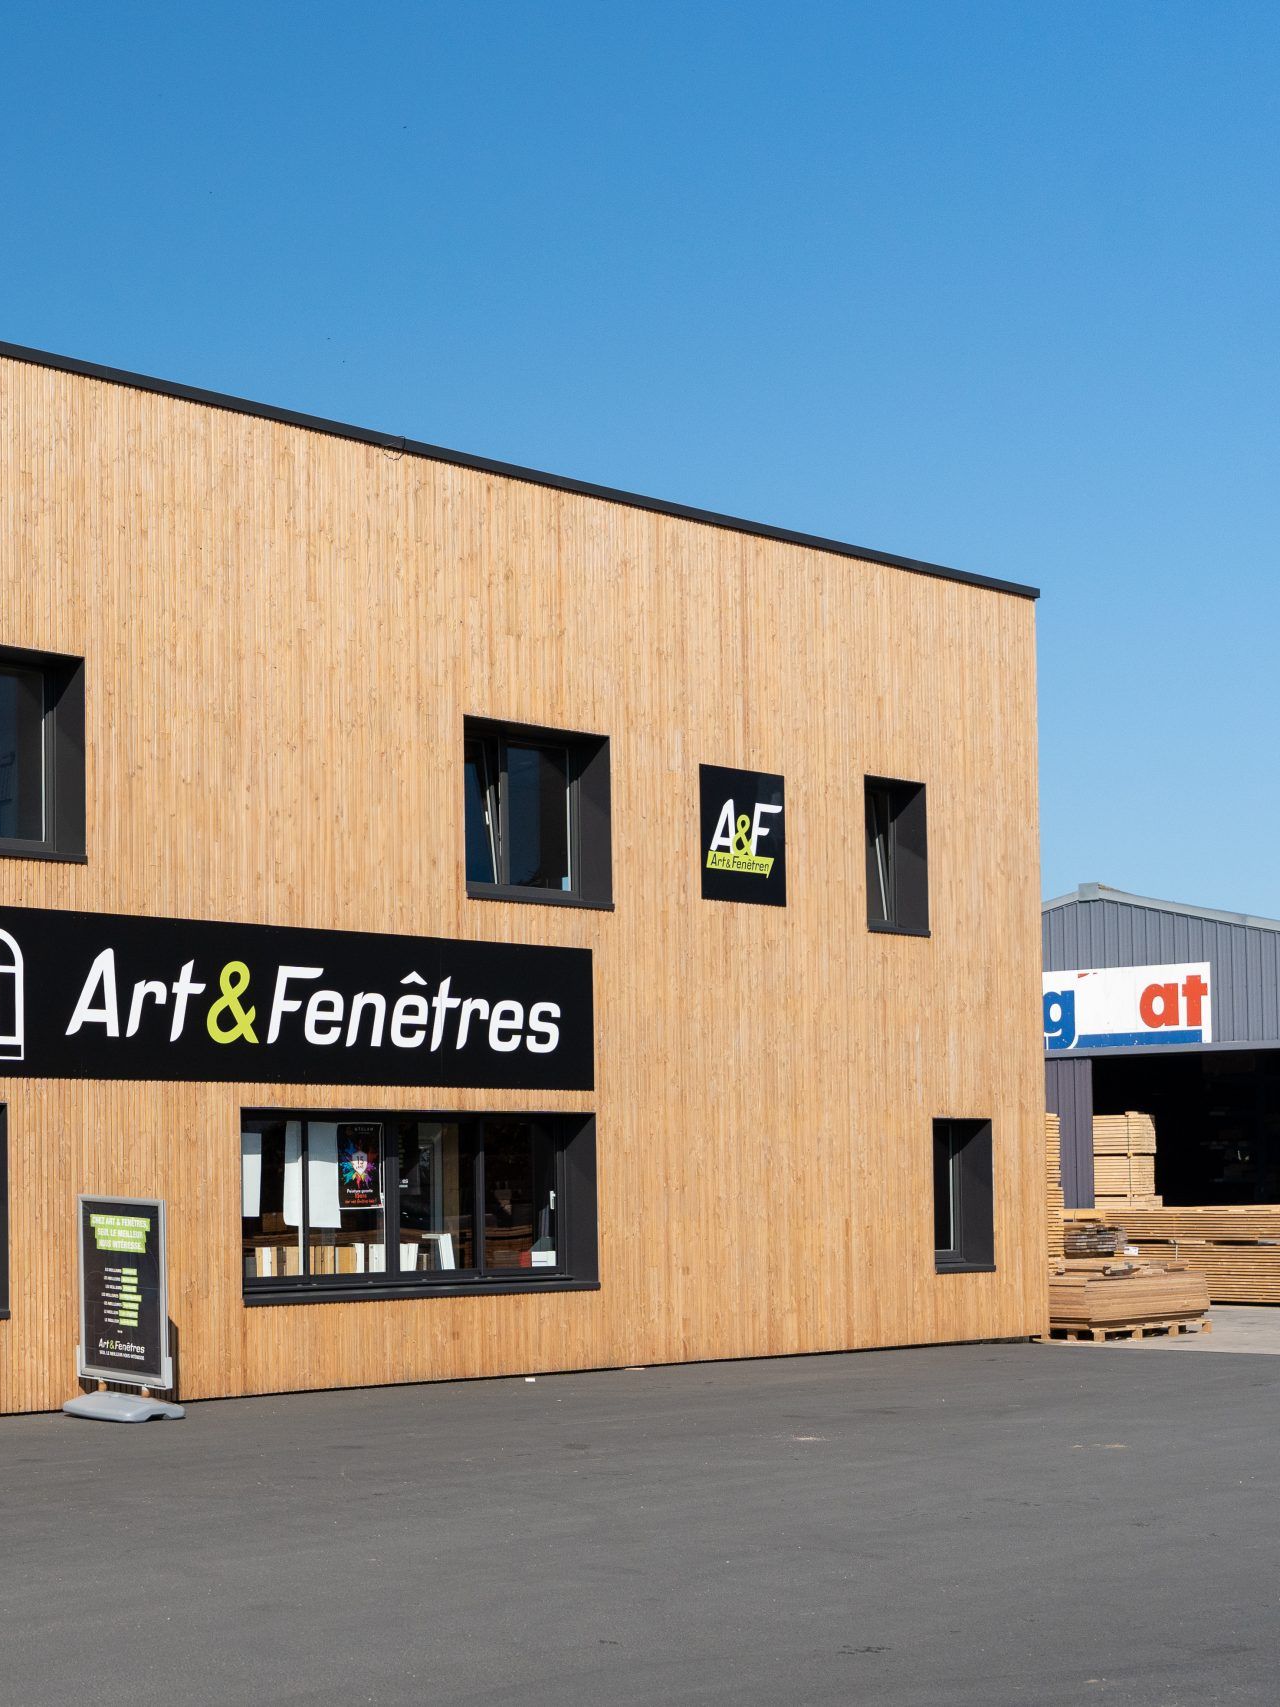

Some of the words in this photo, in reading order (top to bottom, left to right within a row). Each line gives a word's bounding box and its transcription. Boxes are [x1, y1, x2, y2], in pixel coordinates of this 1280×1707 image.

[710, 798, 783, 859] A&F
[65, 947, 561, 1053] Art&Fenêtres
[98, 1337, 145, 1354] Art&Fenêtres
